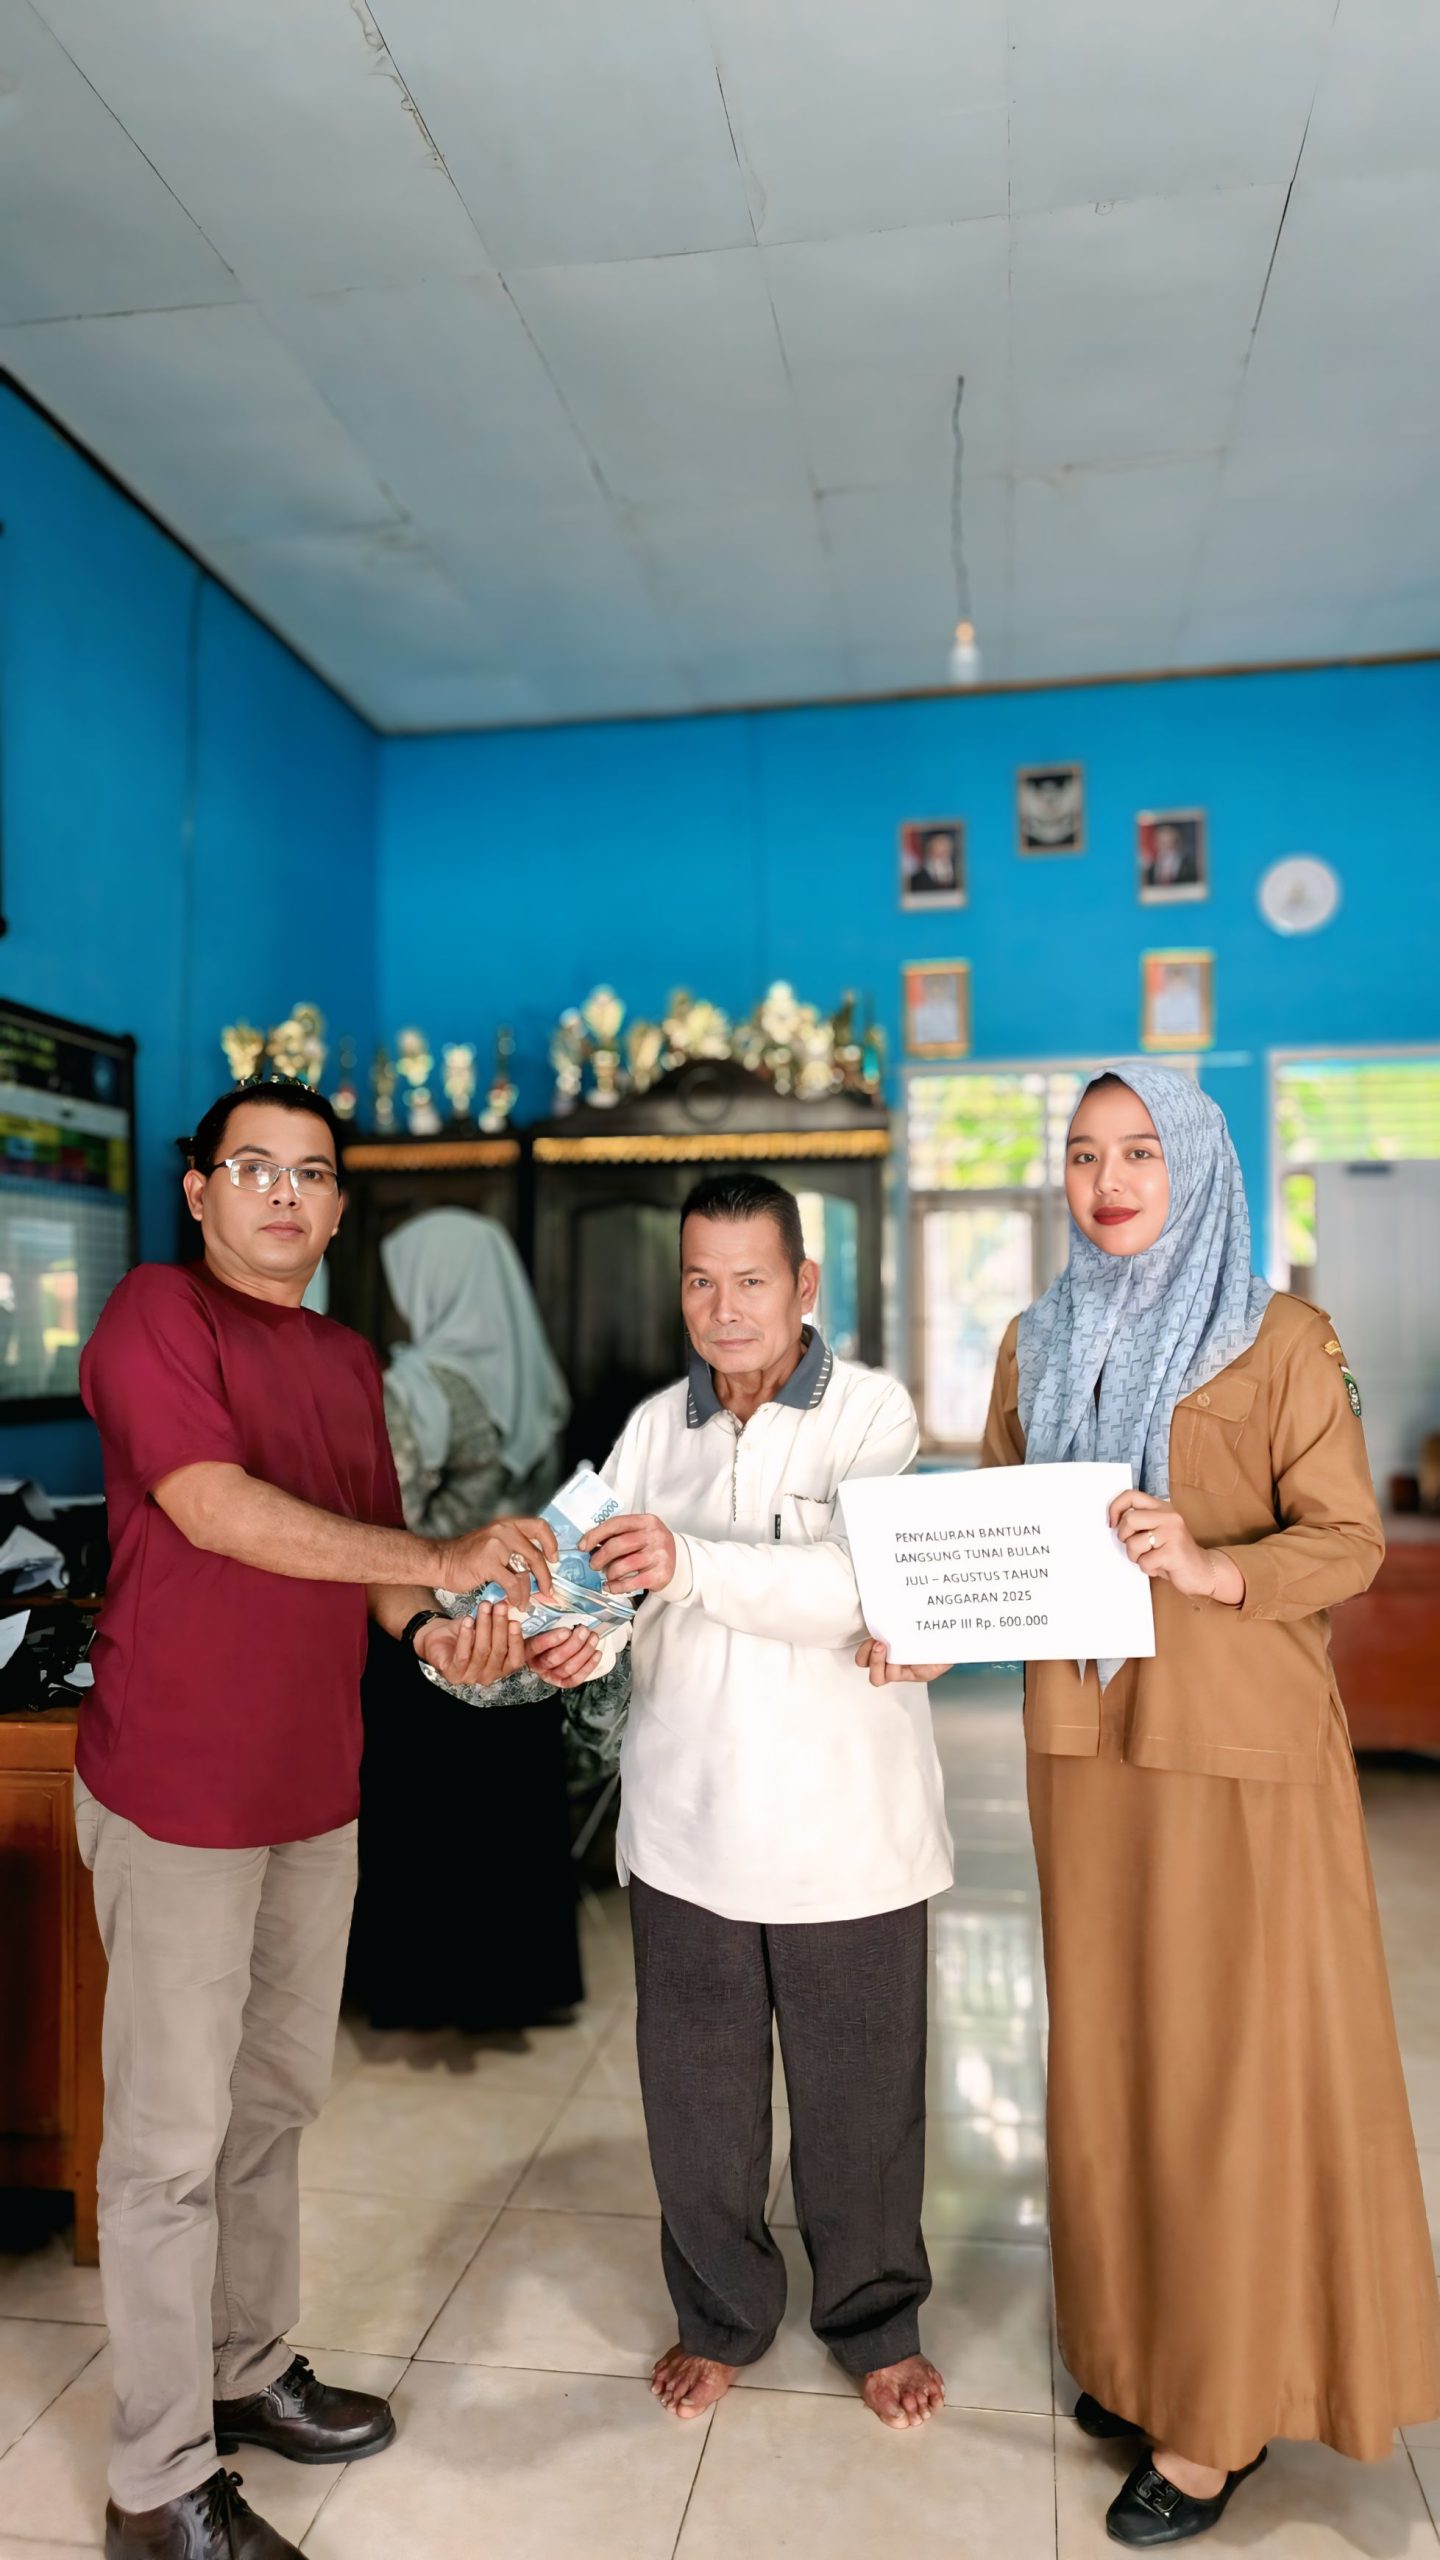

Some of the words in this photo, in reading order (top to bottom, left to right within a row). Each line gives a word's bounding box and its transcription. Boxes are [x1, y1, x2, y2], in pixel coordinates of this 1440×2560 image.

[593, 1500, 619, 1525] 50000
[895, 1529, 976, 1543] PENYALURAN
[978, 1525, 1041, 1538] BANTUAN
[894, 1550, 961, 1563] LANGSUNG
[964, 1547, 1003, 1559] TUNAI
[1007, 1545, 1051, 1557] BULAN
[905, 1575, 929, 1587] JULI
[943, 1571, 1001, 1584] AGUSTUS
[1002, 1568, 1049, 1580] TAHUN
[927, 1592, 998, 1605] ANGGARAN
[1002, 1590, 1032, 1602] 2025
[916, 1618, 957, 1631] TAHAP
[960, 1618, 972, 1629] III
[975, 1617, 996, 1630] Rp.
[999, 1614, 1049, 1628] 600.000
